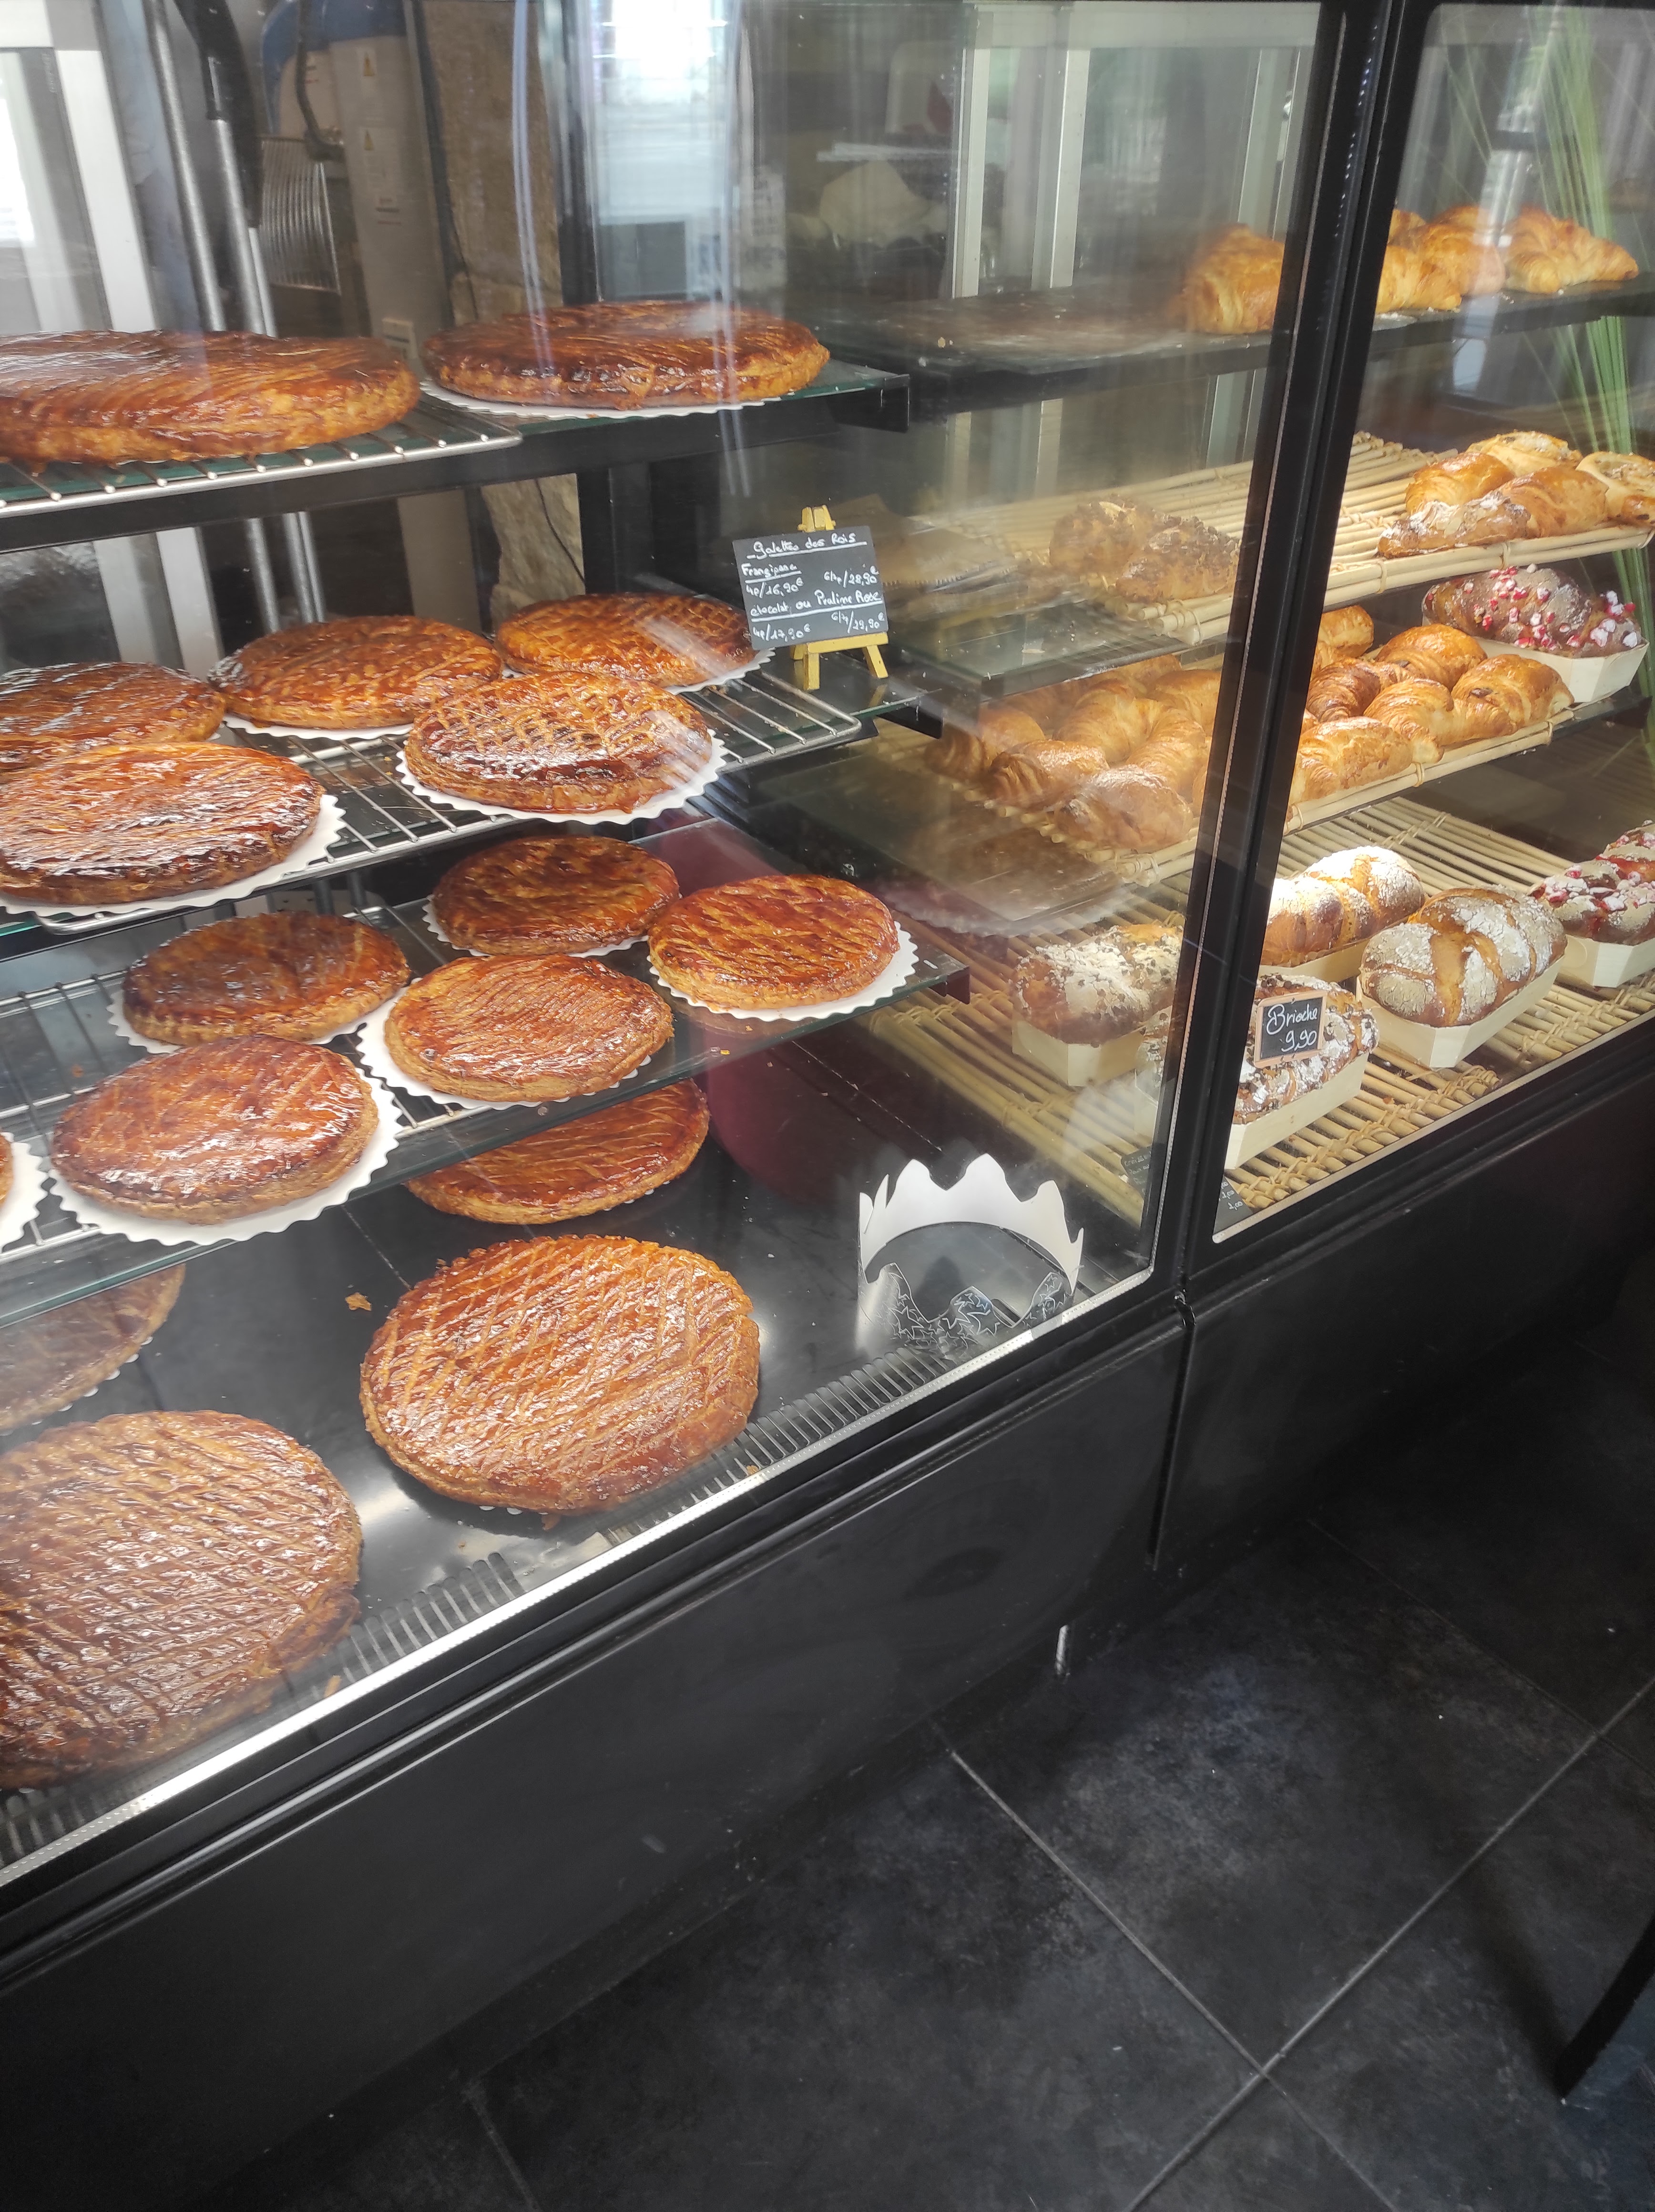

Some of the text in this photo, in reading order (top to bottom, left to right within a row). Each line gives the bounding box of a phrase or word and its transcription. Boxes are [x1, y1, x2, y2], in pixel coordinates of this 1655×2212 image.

[805, 536, 825, 549] des
[831, 533, 857, 545] Rois
[796, 600, 812, 610] ou
[1267, 1003, 1318, 1035] Brioche
[1281, 1028, 1317, 1052] 9,90
